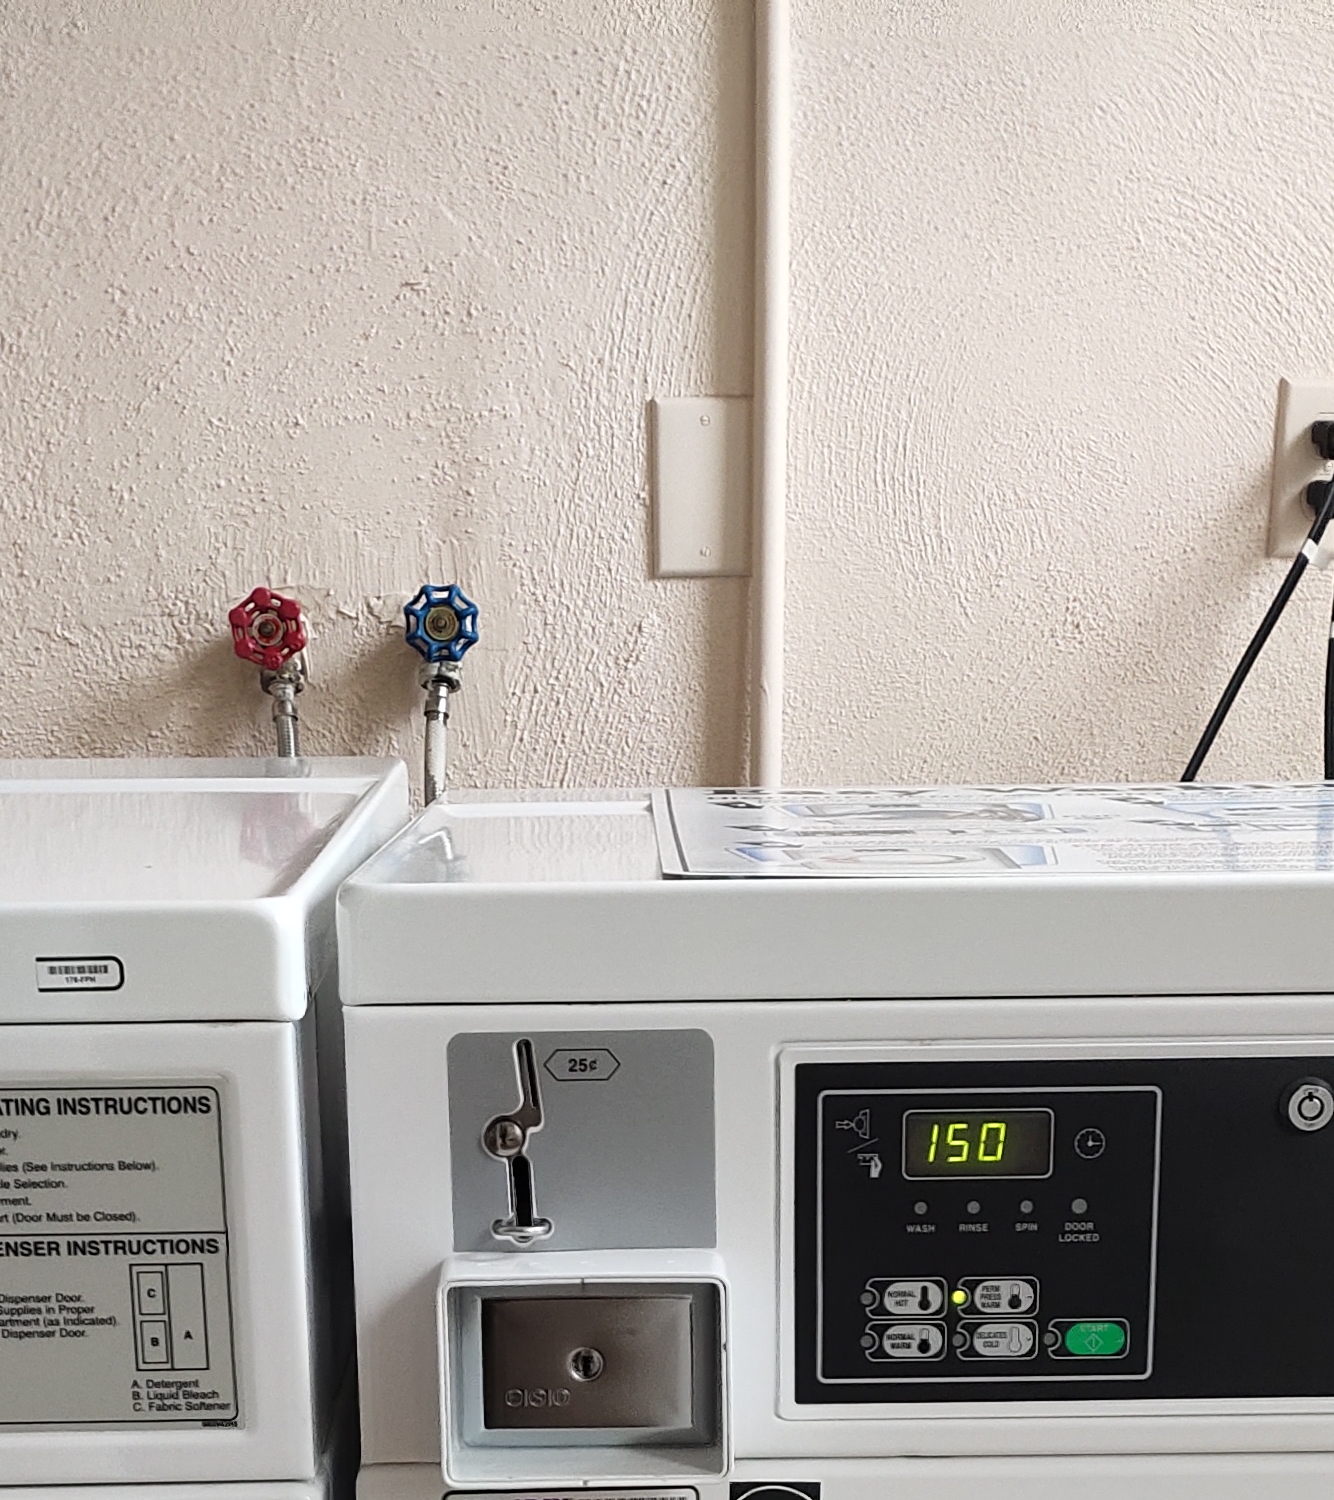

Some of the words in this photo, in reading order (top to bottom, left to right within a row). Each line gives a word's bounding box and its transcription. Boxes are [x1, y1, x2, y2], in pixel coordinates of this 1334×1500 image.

[568, 1058, 598, 1073] 25¢
[56, 1095, 211, 1115] INSTRUCTIONS
[927, 1122, 1007, 1162] 150
[21, 1161, 47, 1173] (See
[50, 1161, 114, 1171] Instructions
[11, 1212, 42, 1224] (Door
[45, 1211, 73, 1222] Must
[75, 1211, 90, 1222] be
[906, 1224, 935, 1232] WASH
[958, 1223, 988, 1232] RINSE
[1015, 1222, 1037, 1231] SPIN
[1064, 1221, 1093, 1230] DOOR
[1058, 1233, 1099, 1242] LOCKED
[66, 1238, 219, 1256] INSTRUCTIONS
